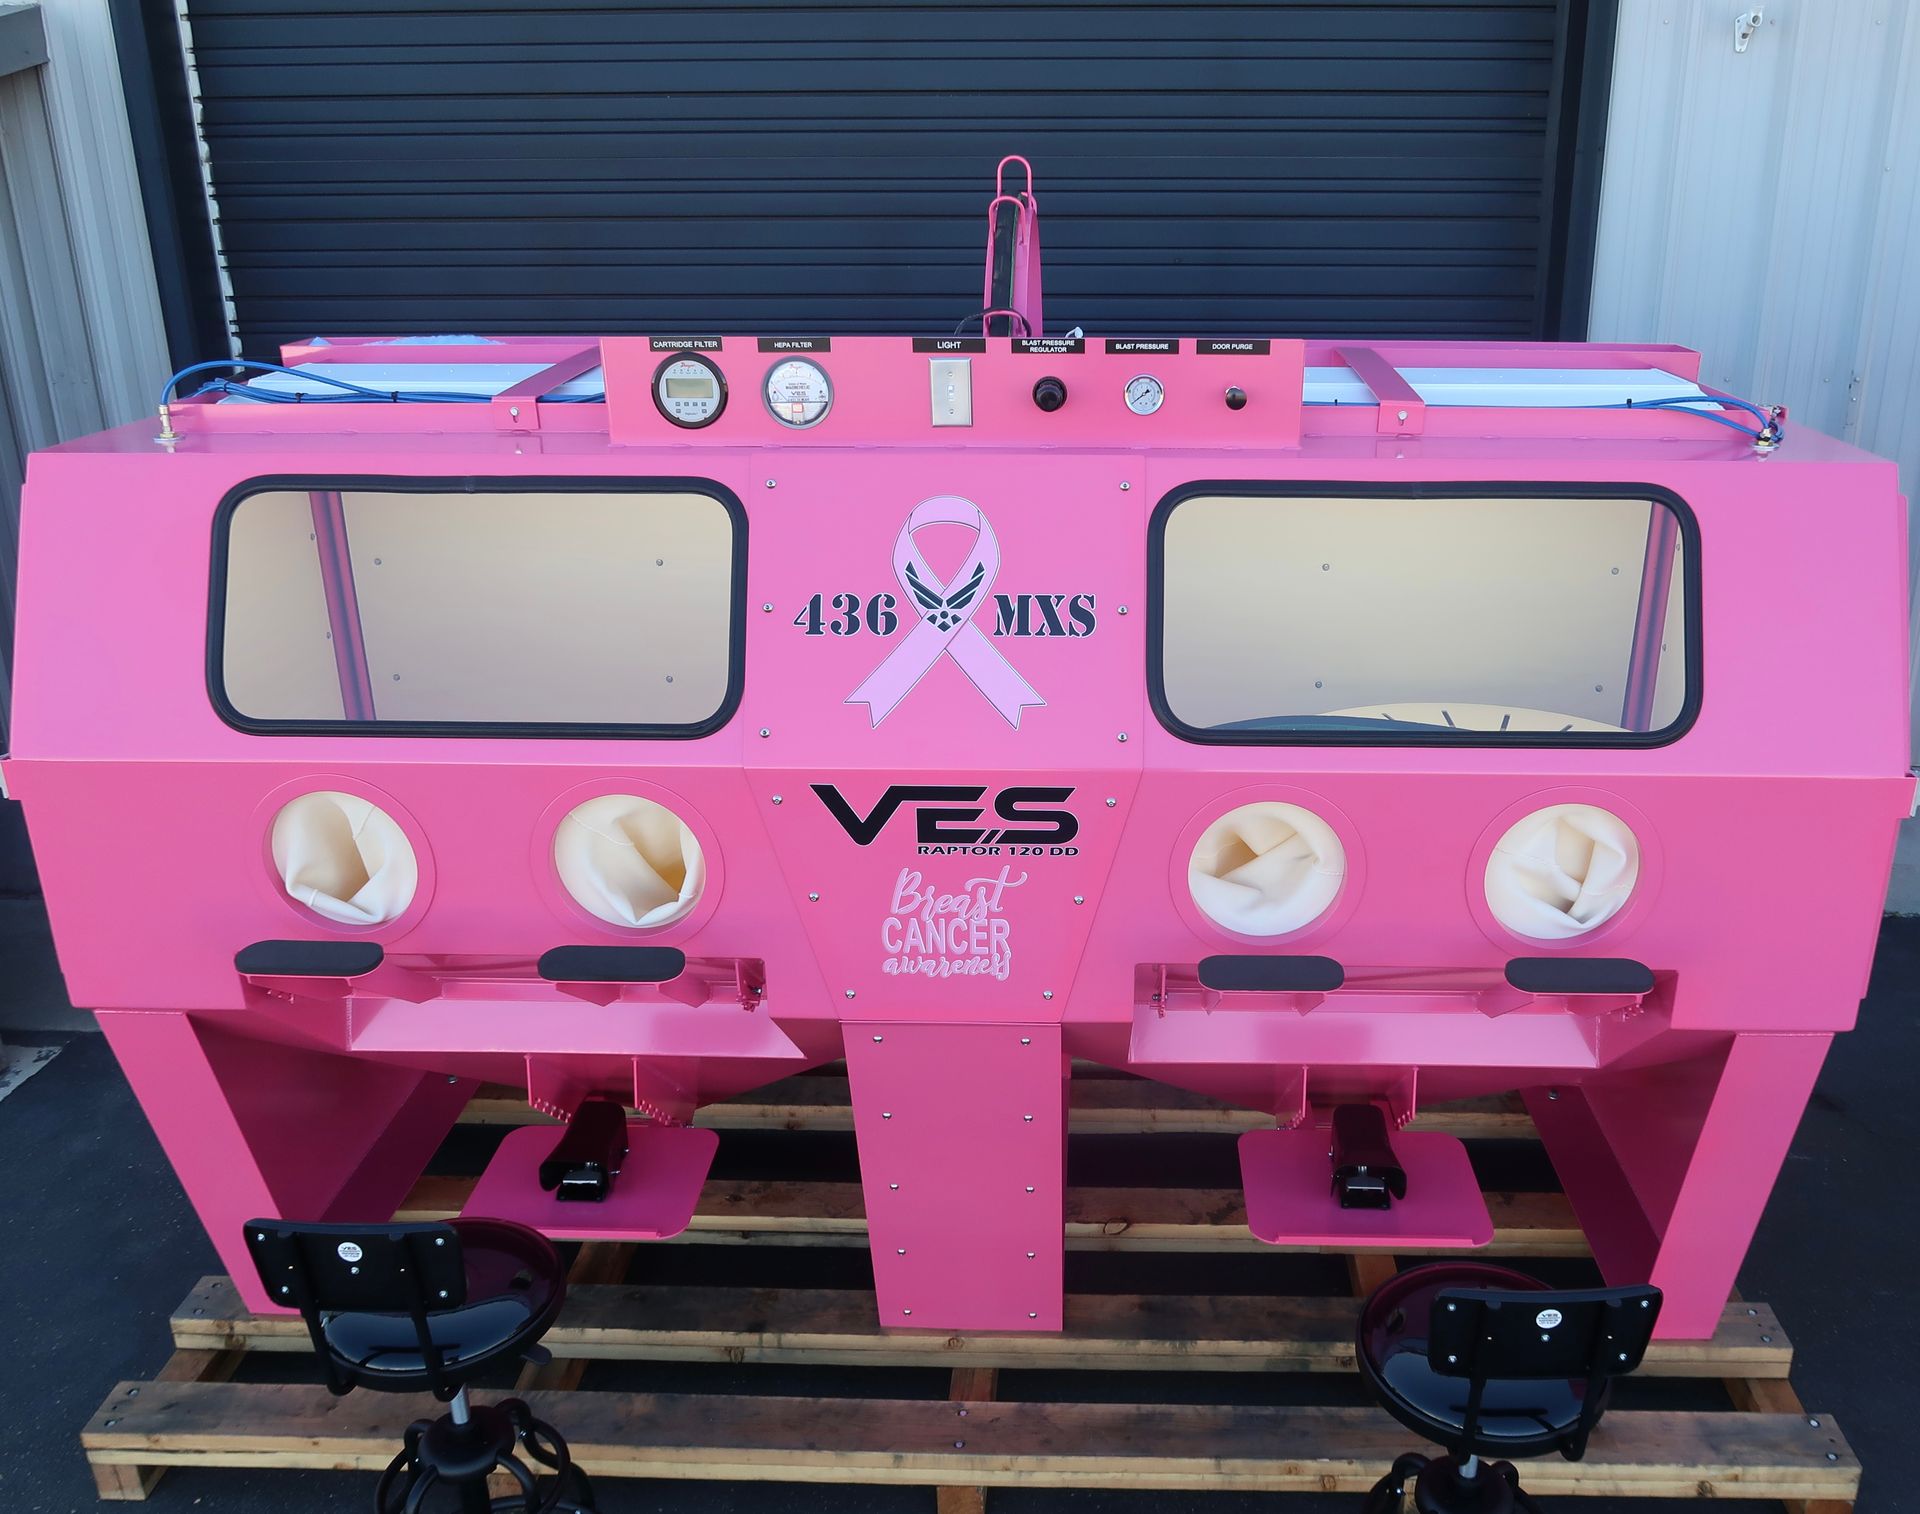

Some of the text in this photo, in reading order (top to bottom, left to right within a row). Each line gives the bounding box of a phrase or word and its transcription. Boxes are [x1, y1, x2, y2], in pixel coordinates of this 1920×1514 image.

[653, 340, 718, 348] CARTRIDGE FILTER
[774, 341, 813, 349] HEPA FILTER
[937, 341, 961, 350] LIGHT
[1021, 339, 1075, 347] BLAST PRESSURE
[793, 592, 1097, 637] 436 MXS
[809, 783, 1080, 846] VES
[917, 846, 1080, 856] RAPTOR 120 DD
[890, 865, 1028, 922] Breast
[881, 917, 1011, 955] CANCER
[881, 950, 1012, 982] awareness
